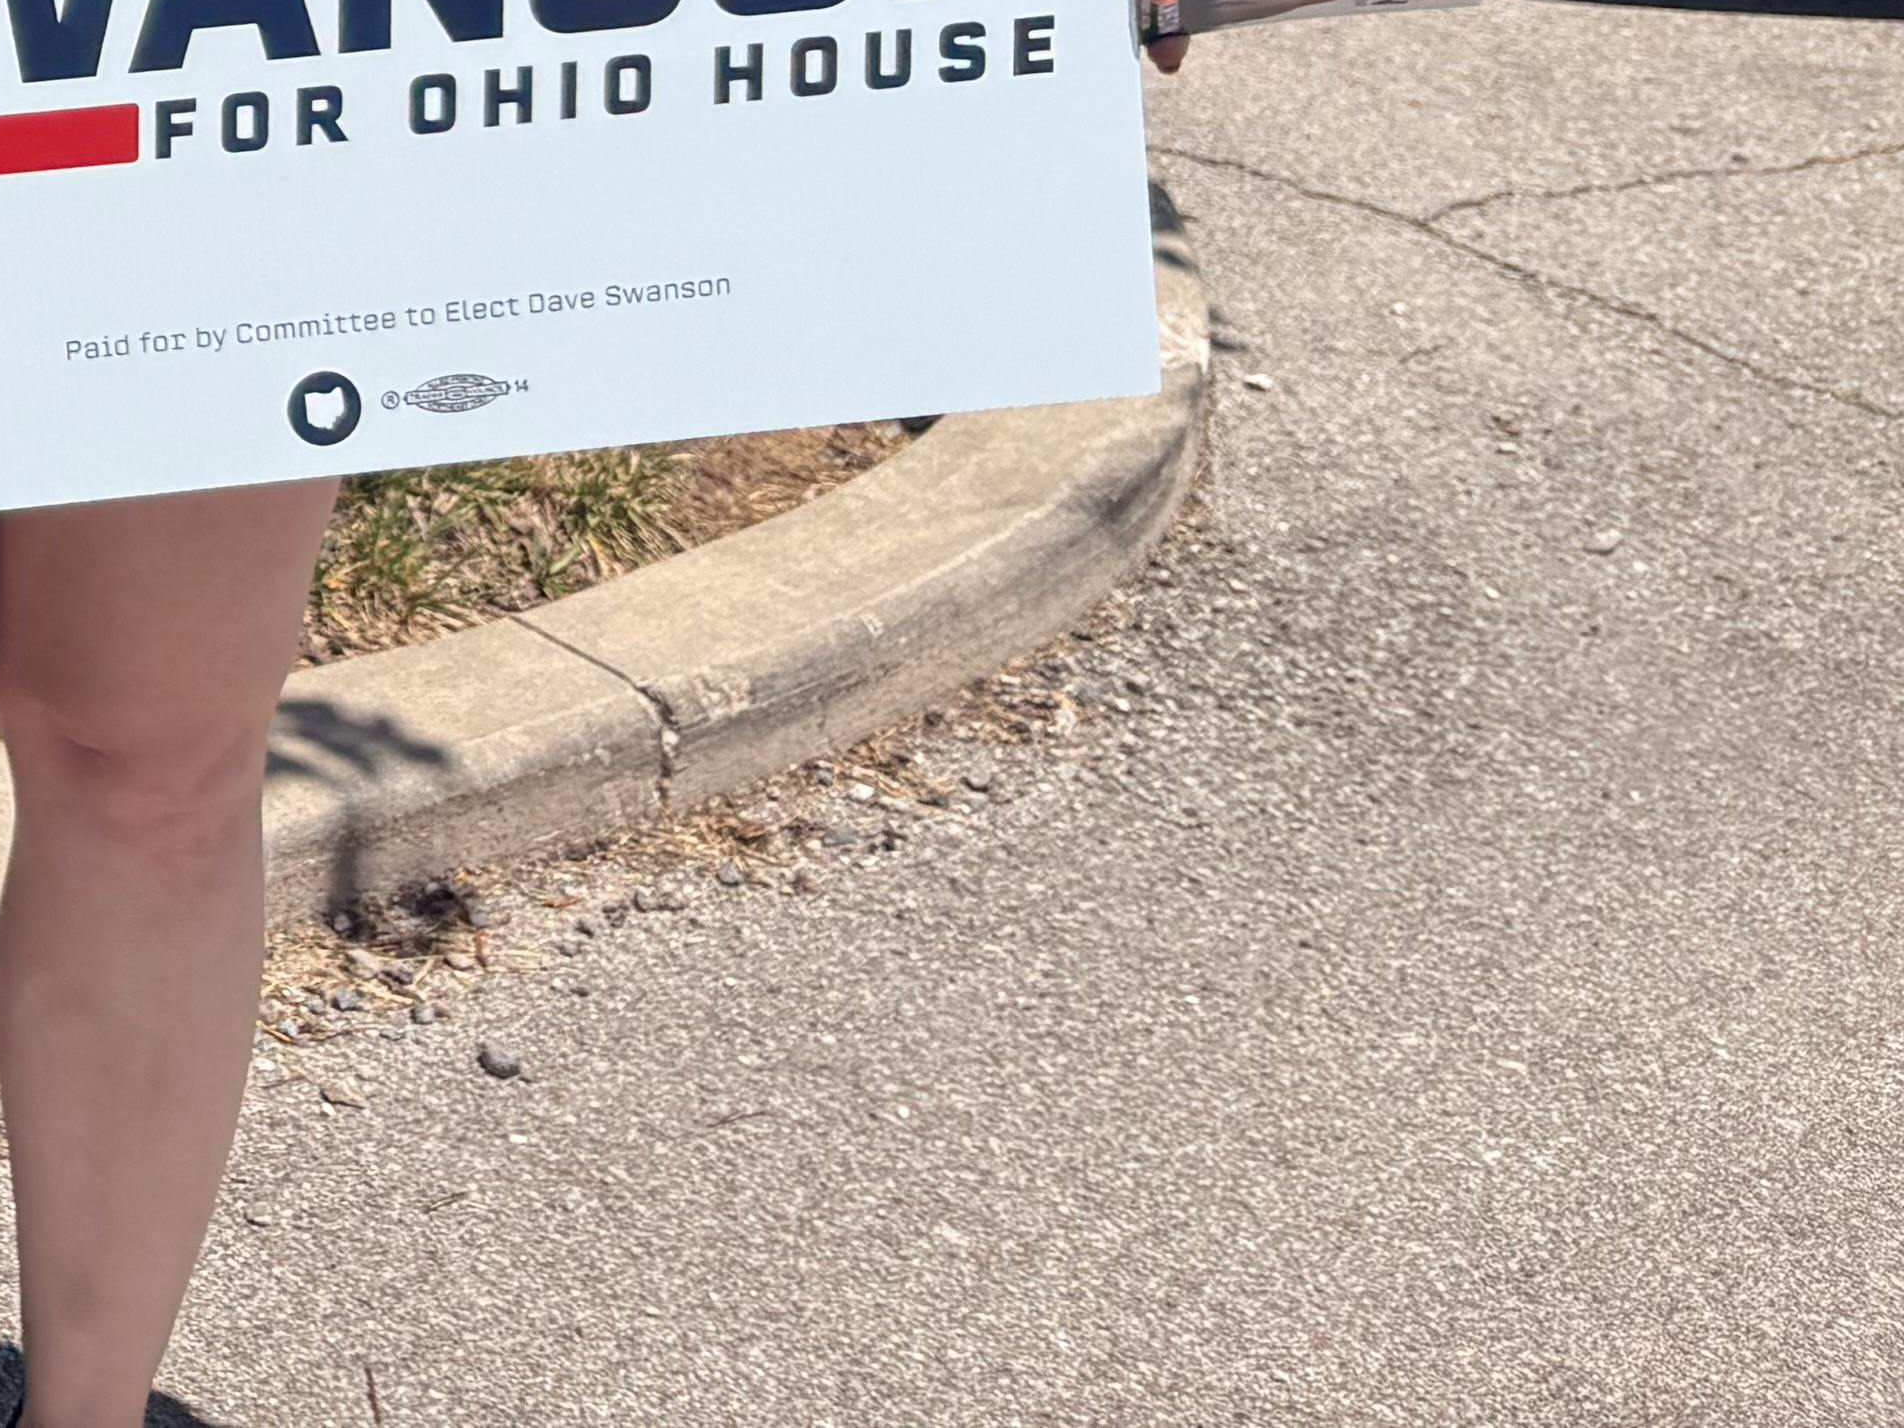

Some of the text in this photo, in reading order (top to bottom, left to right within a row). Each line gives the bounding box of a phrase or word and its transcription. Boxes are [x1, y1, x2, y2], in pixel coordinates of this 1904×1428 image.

[155, 15, 1055, 158] FOR OHIO HOUSE
[66, 275, 731, 361] Paid for by Committee to Elect Dave Swanson
[515, 379, 528, 392] 14
